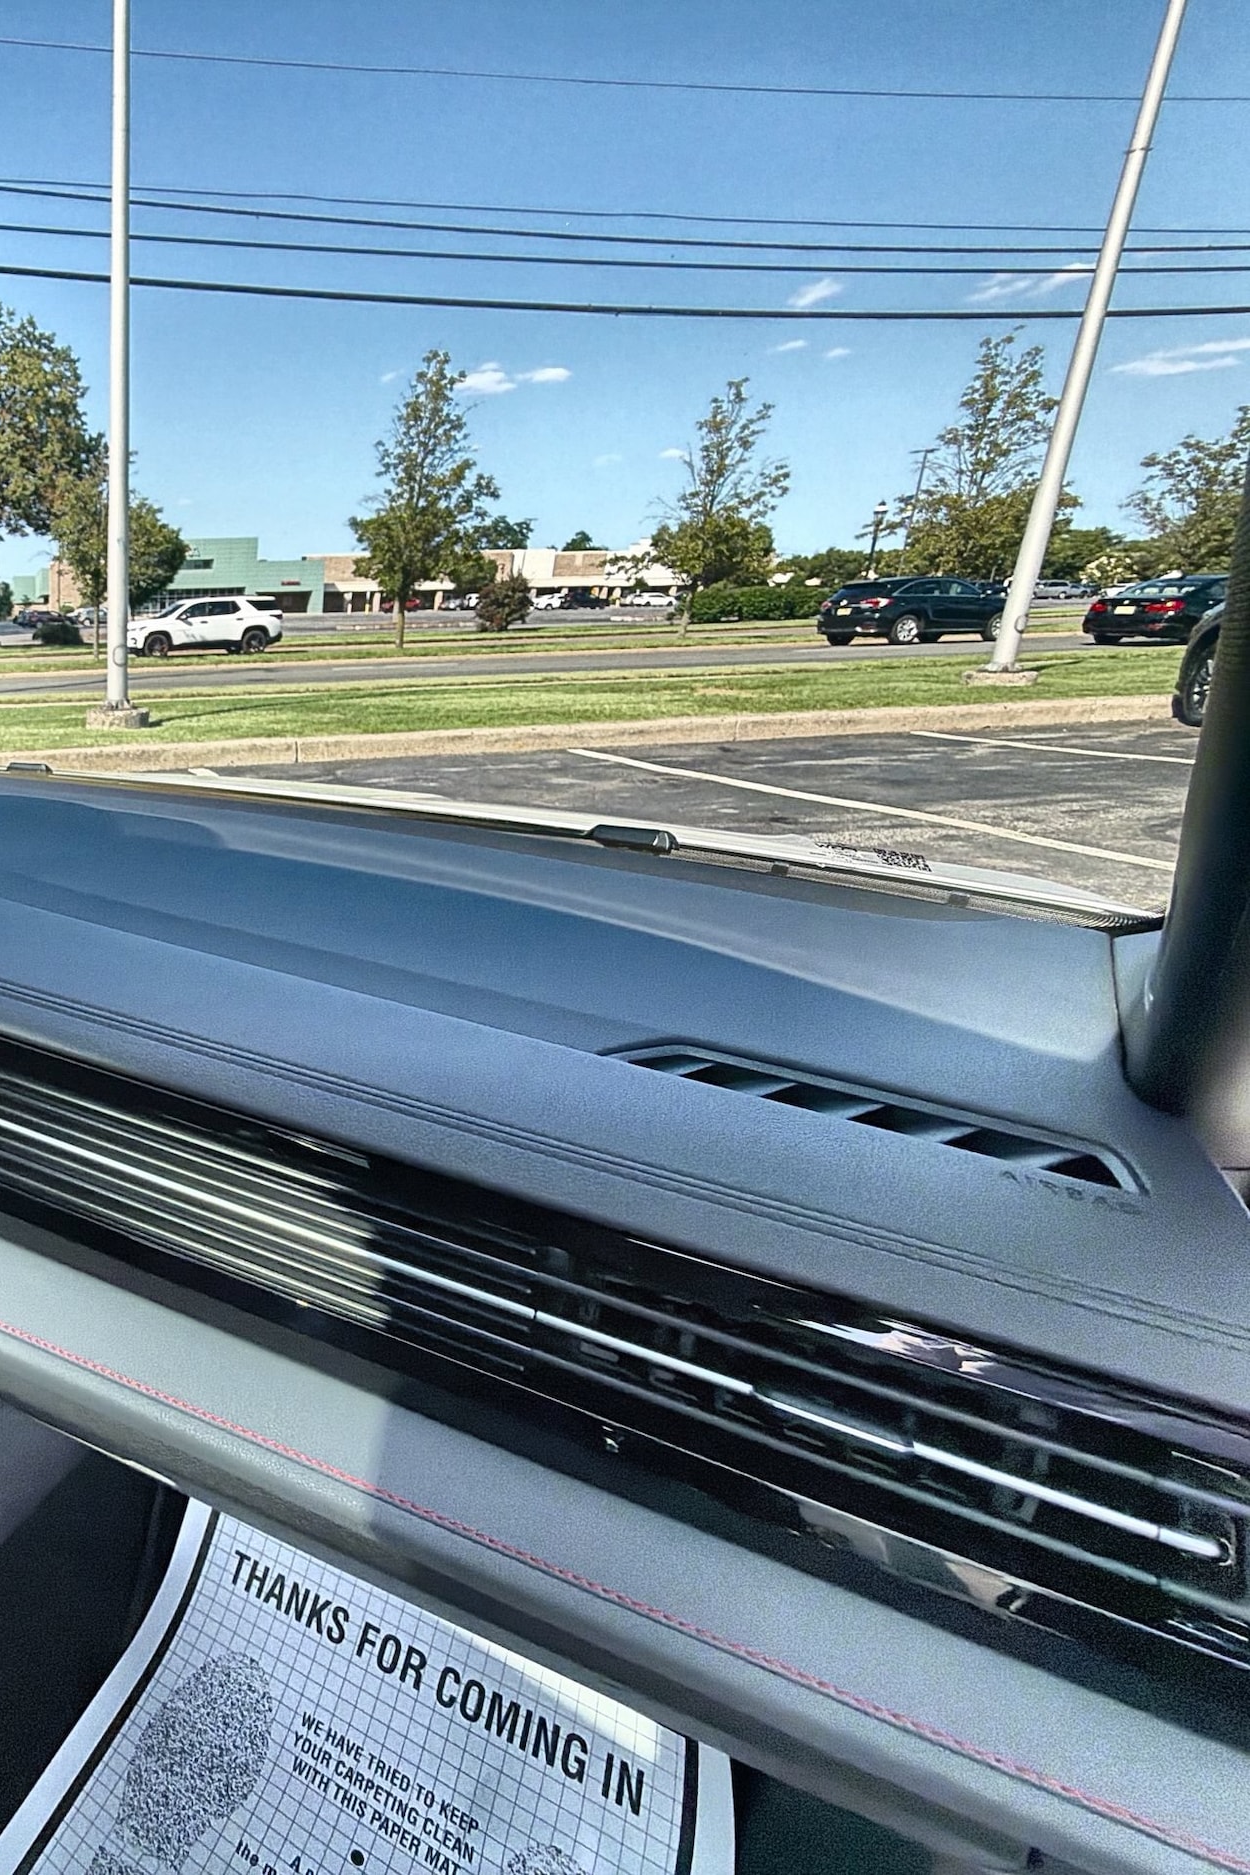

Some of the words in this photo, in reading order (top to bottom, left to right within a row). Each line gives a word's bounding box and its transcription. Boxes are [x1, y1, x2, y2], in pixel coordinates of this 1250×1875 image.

[231, 1550, 350, 1644] THANKS
[355, 1621, 427, 1691] FOR
[436, 1666, 589, 1784] COMING
[601, 1752, 645, 1816] IN
[291, 1755, 330, 1794] WITH
[332, 1783, 368, 1818] THIS
[370, 1809, 422, 1856] PAPER
[424, 1844, 463, 1875] MAT
[293, 1731, 333, 1769] YOUR
[334, 1760, 420, 1826] CARPETING
[423, 1817, 475, 1864] CLEAN
[301, 1711, 325, 1737] WE
[325, 1727, 364, 1763] HAVE
[367, 1752, 411, 1792] TRIED
[415, 1782, 436, 1808] TO
[439, 1799, 479, 1834] KEEP
[235, 1838, 259, 1867] the
